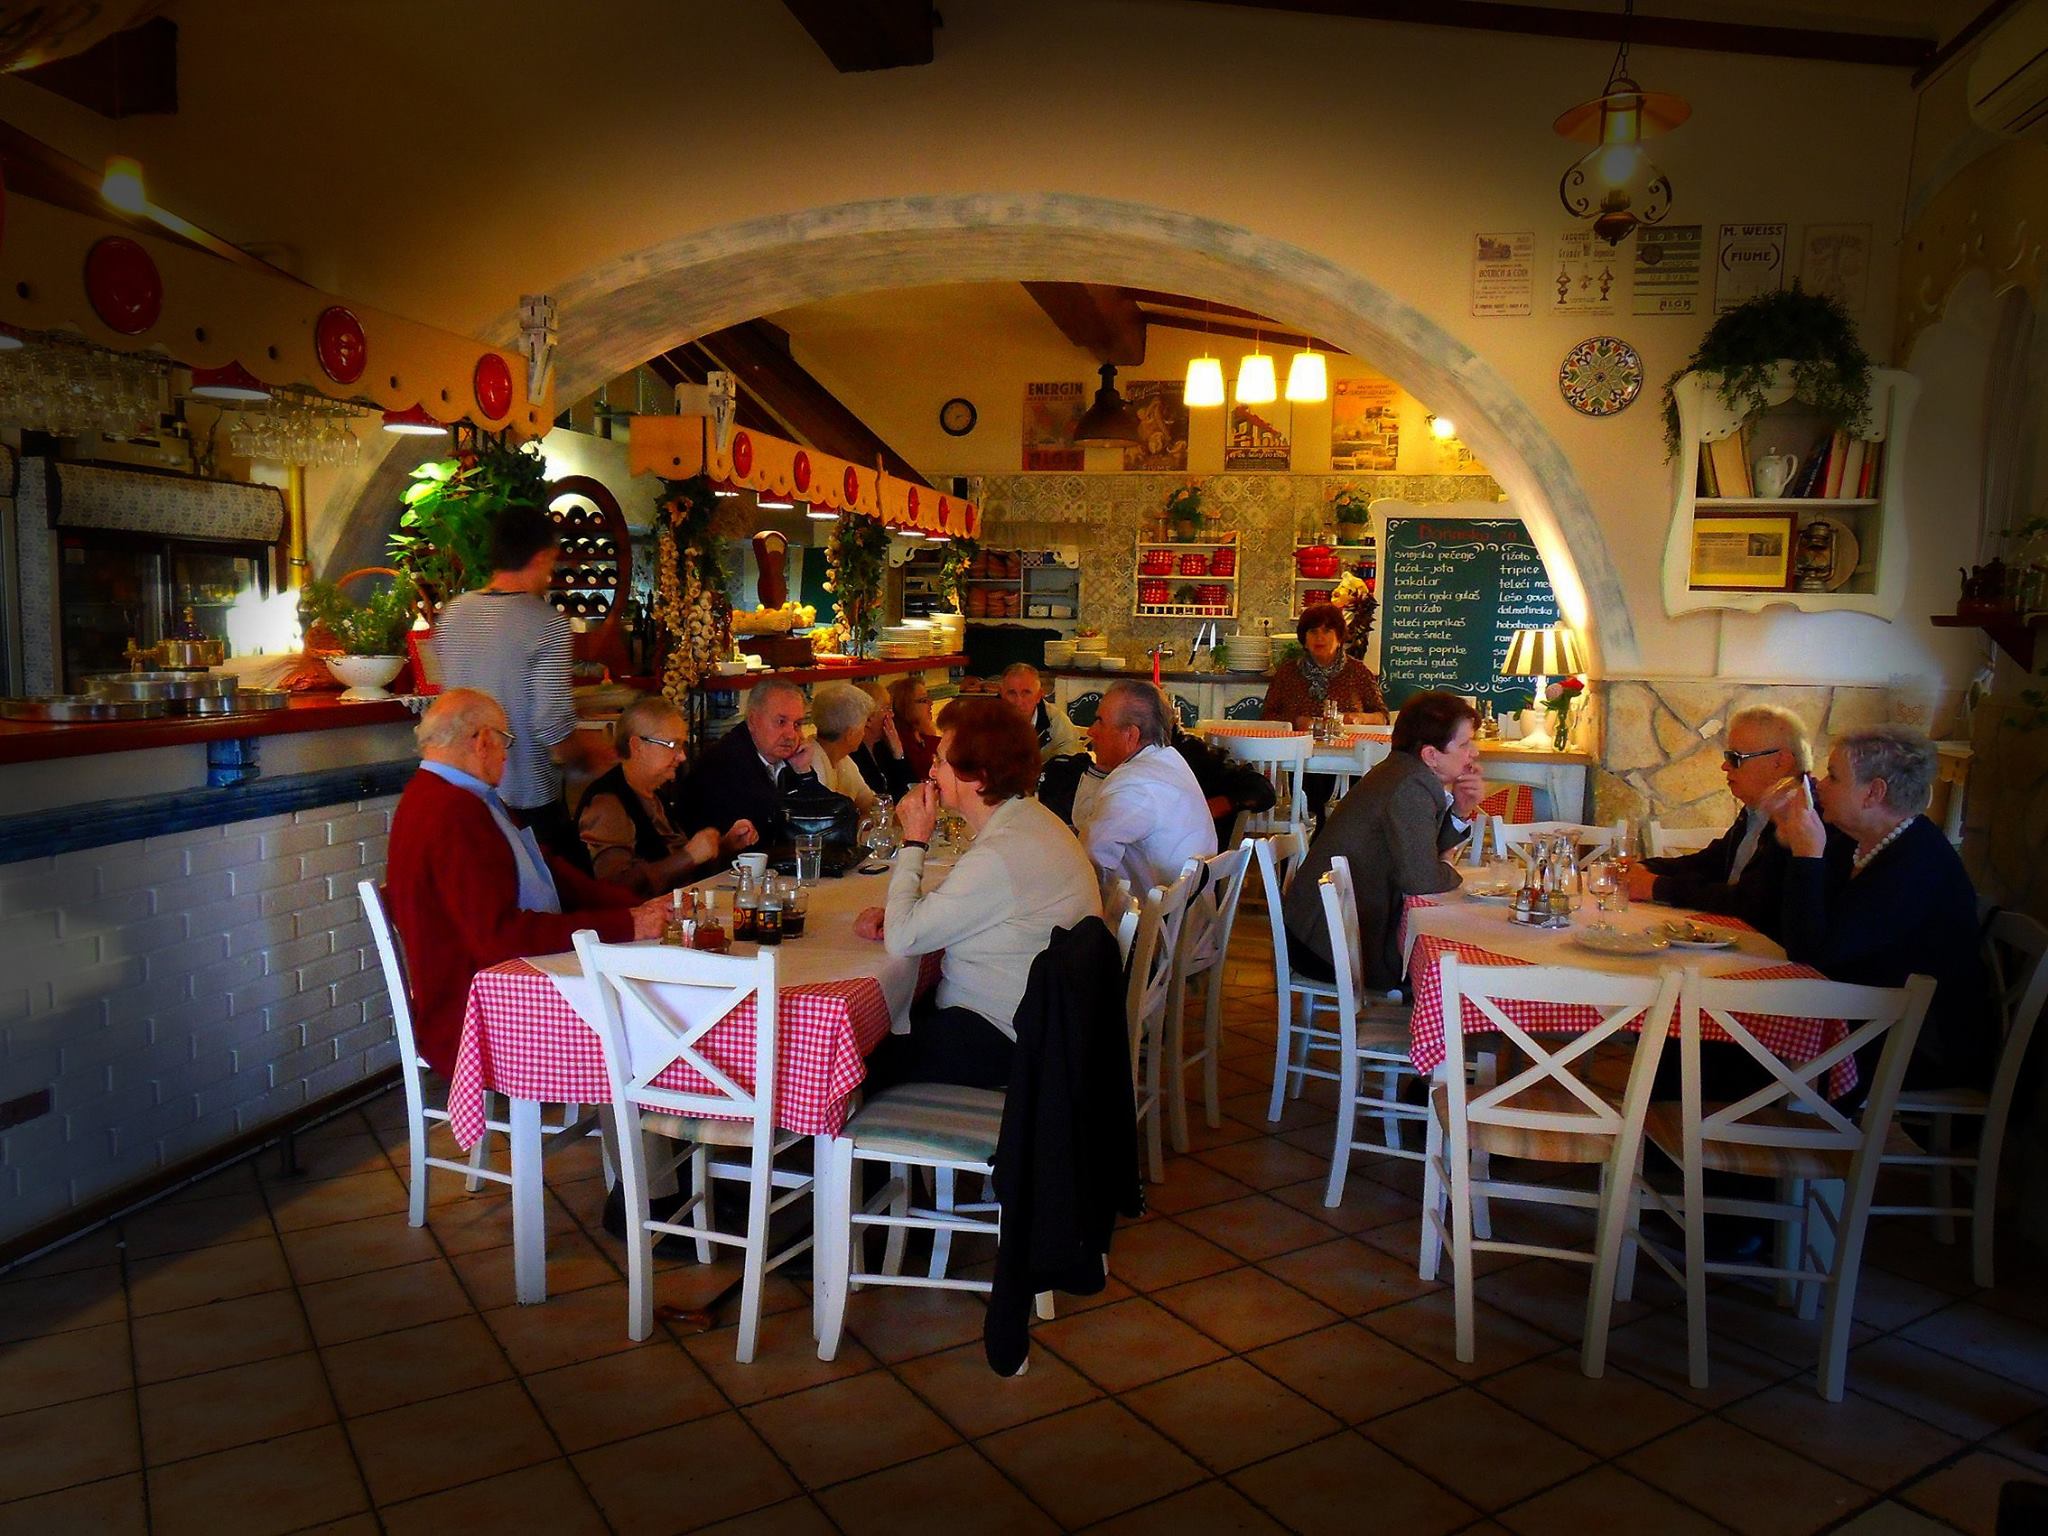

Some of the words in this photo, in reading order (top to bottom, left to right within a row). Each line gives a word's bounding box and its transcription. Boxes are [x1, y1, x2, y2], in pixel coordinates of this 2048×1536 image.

[1743, 226, 1783, 236] WEISS
[1028, 382, 1083, 395] ENERGIN
[1500, 564, 1539, 576] tripice
